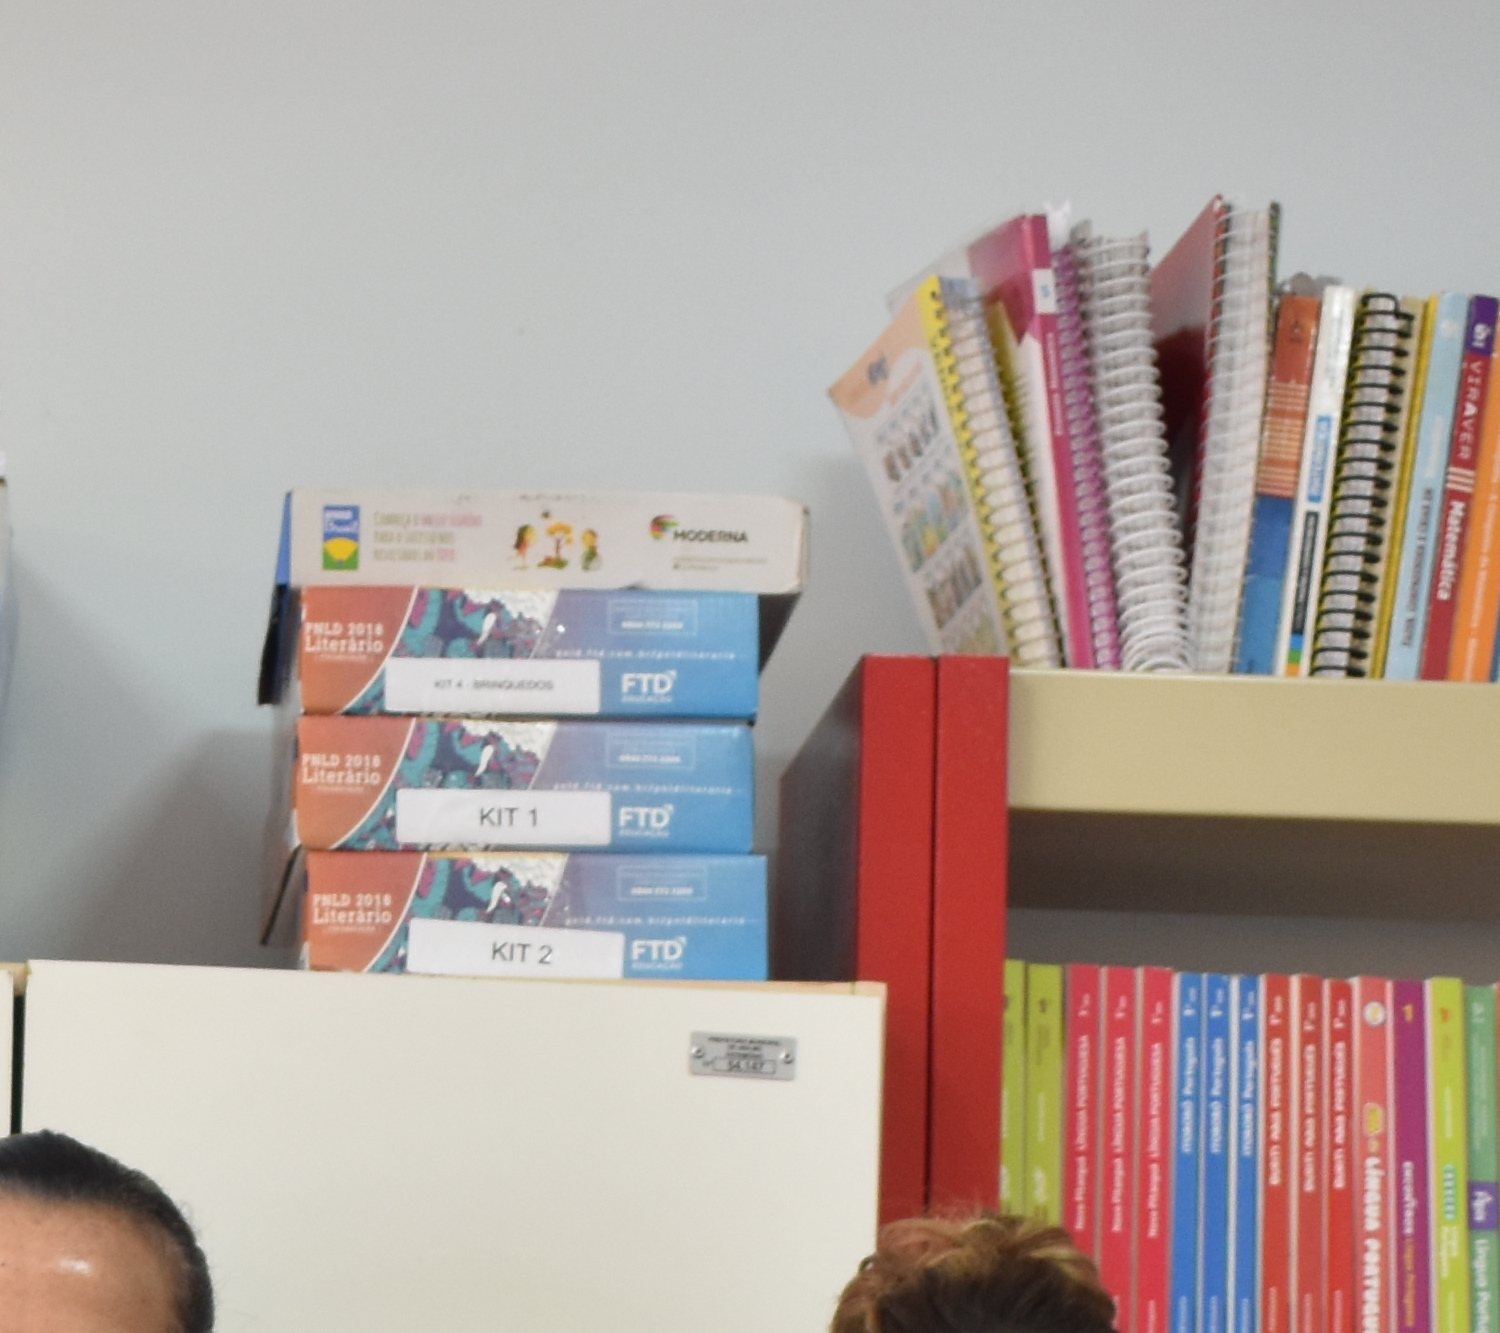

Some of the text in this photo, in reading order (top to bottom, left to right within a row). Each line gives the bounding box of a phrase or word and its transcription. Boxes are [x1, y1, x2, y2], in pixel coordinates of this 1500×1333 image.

[673, 529, 748, 543] MODERNA
[1436, 501, 1466, 602] Matemática
[473, 678, 553, 691] BRINQUEDOS
[622, 669, 677, 693] FTD
[480, 808, 538, 827] KIT 1
[619, 804, 673, 829] FTD
[491, 942, 552, 966] KIT 2
[632, 936, 686, 960] FTD
[1363, 1156, 1386, 1232] LÍNGUA
